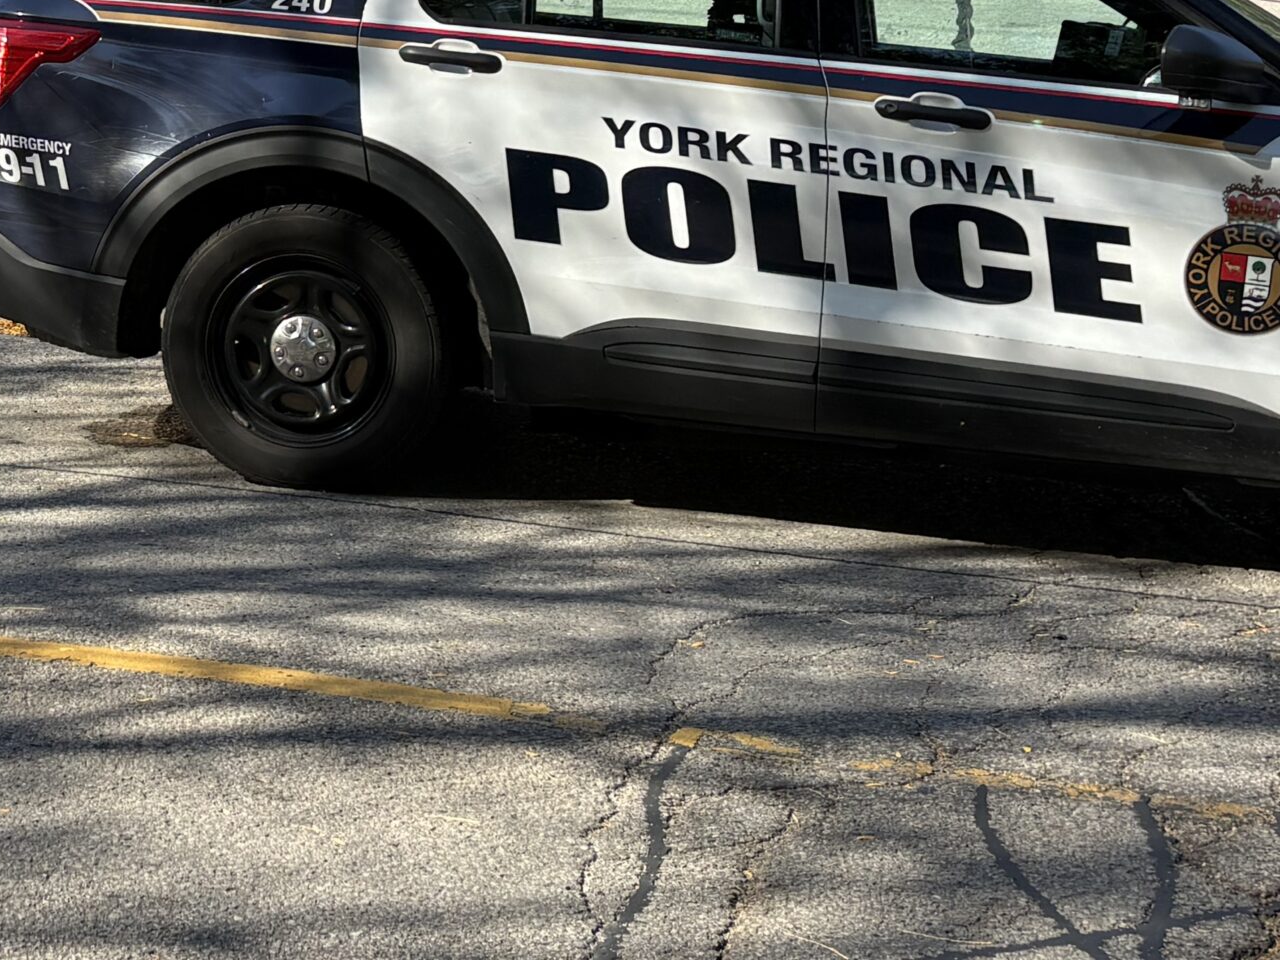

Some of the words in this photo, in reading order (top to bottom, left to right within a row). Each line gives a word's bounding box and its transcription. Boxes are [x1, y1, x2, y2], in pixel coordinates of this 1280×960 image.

[601, 116, 752, 166] YORK
[770, 137, 1055, 204] REGIONAL
[505, 147, 1144, 324] POLICE
[1188, 236, 1222, 302] YORK
[1203, 301, 1280, 331] POLICE
